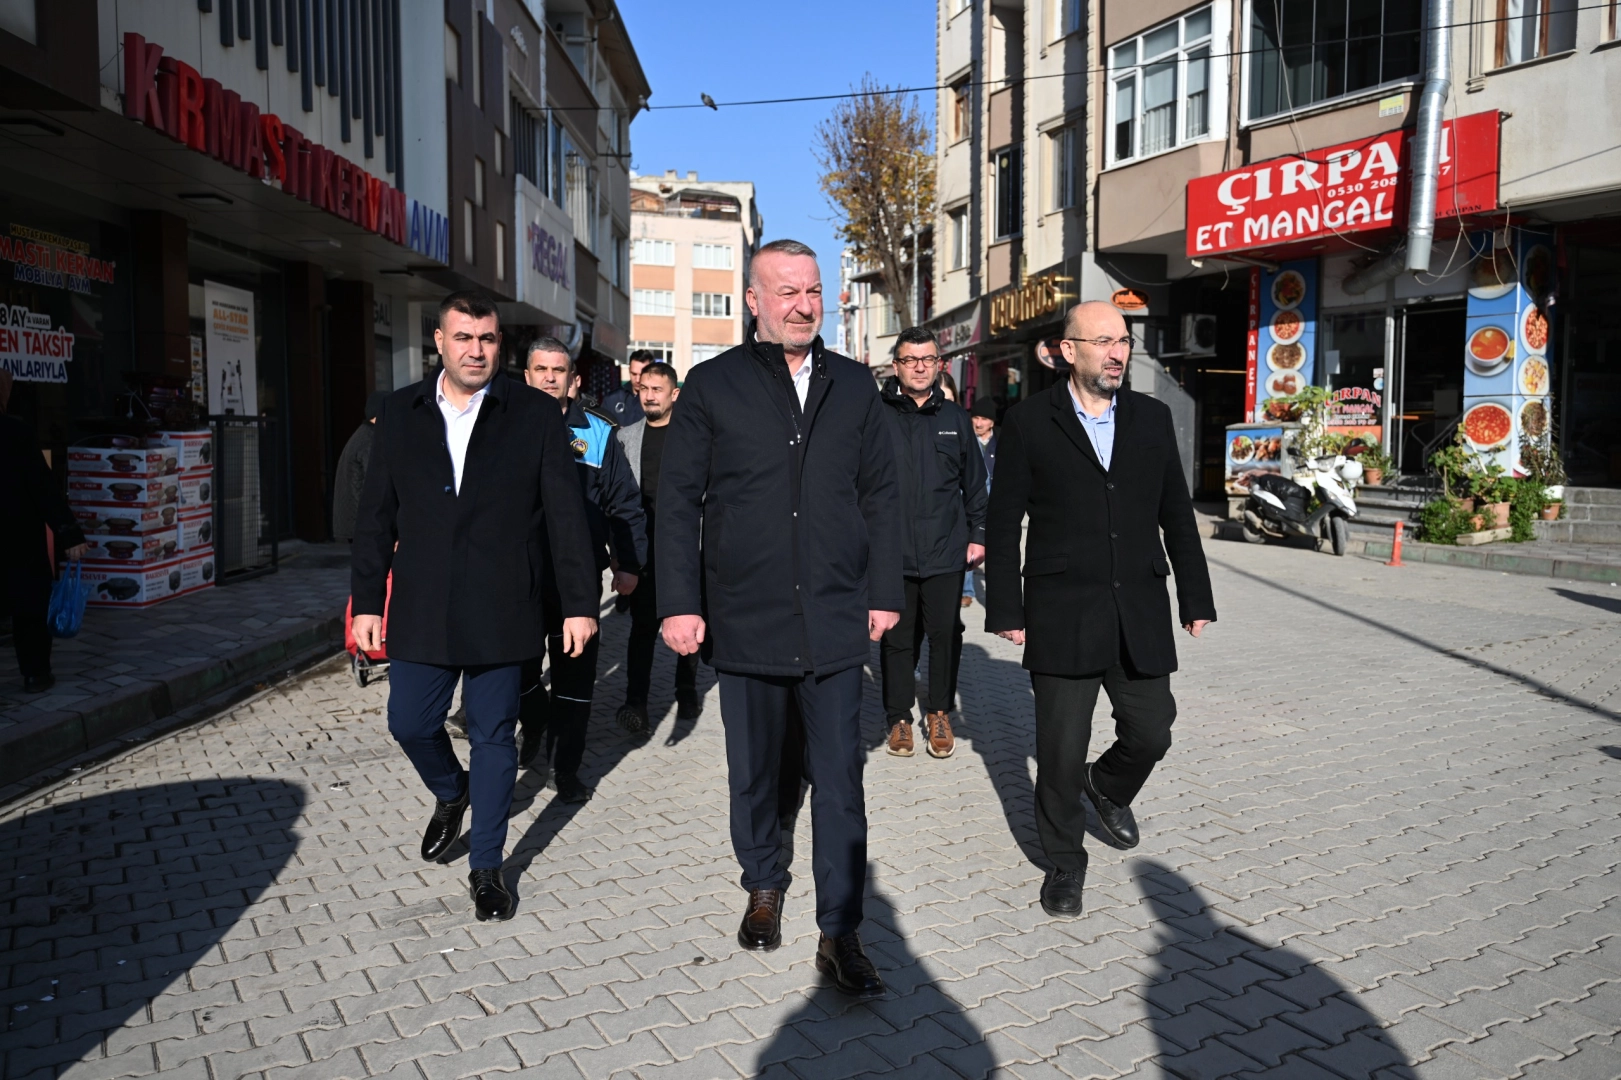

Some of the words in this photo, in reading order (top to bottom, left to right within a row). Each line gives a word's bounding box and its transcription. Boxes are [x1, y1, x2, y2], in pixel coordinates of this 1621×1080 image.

[1327, 183, 1364, 198] 0530
[1370, 176, 1398, 190] 208
[410, 199, 448, 264] AVM
[1196, 222, 1233, 251] ET
[1243, 192, 1393, 244] MANGAL
[55, 248, 114, 284] KERVAN
[531, 222, 571, 291] REGAL
[68, 275, 92, 295] AVM
[33, 316, 50, 326] VARAN
[213, 308, 248, 326] ALL-STAR
[23, 329, 73, 358] TAKSİT
[0, 358, 66, 379] ANLARIYLA
